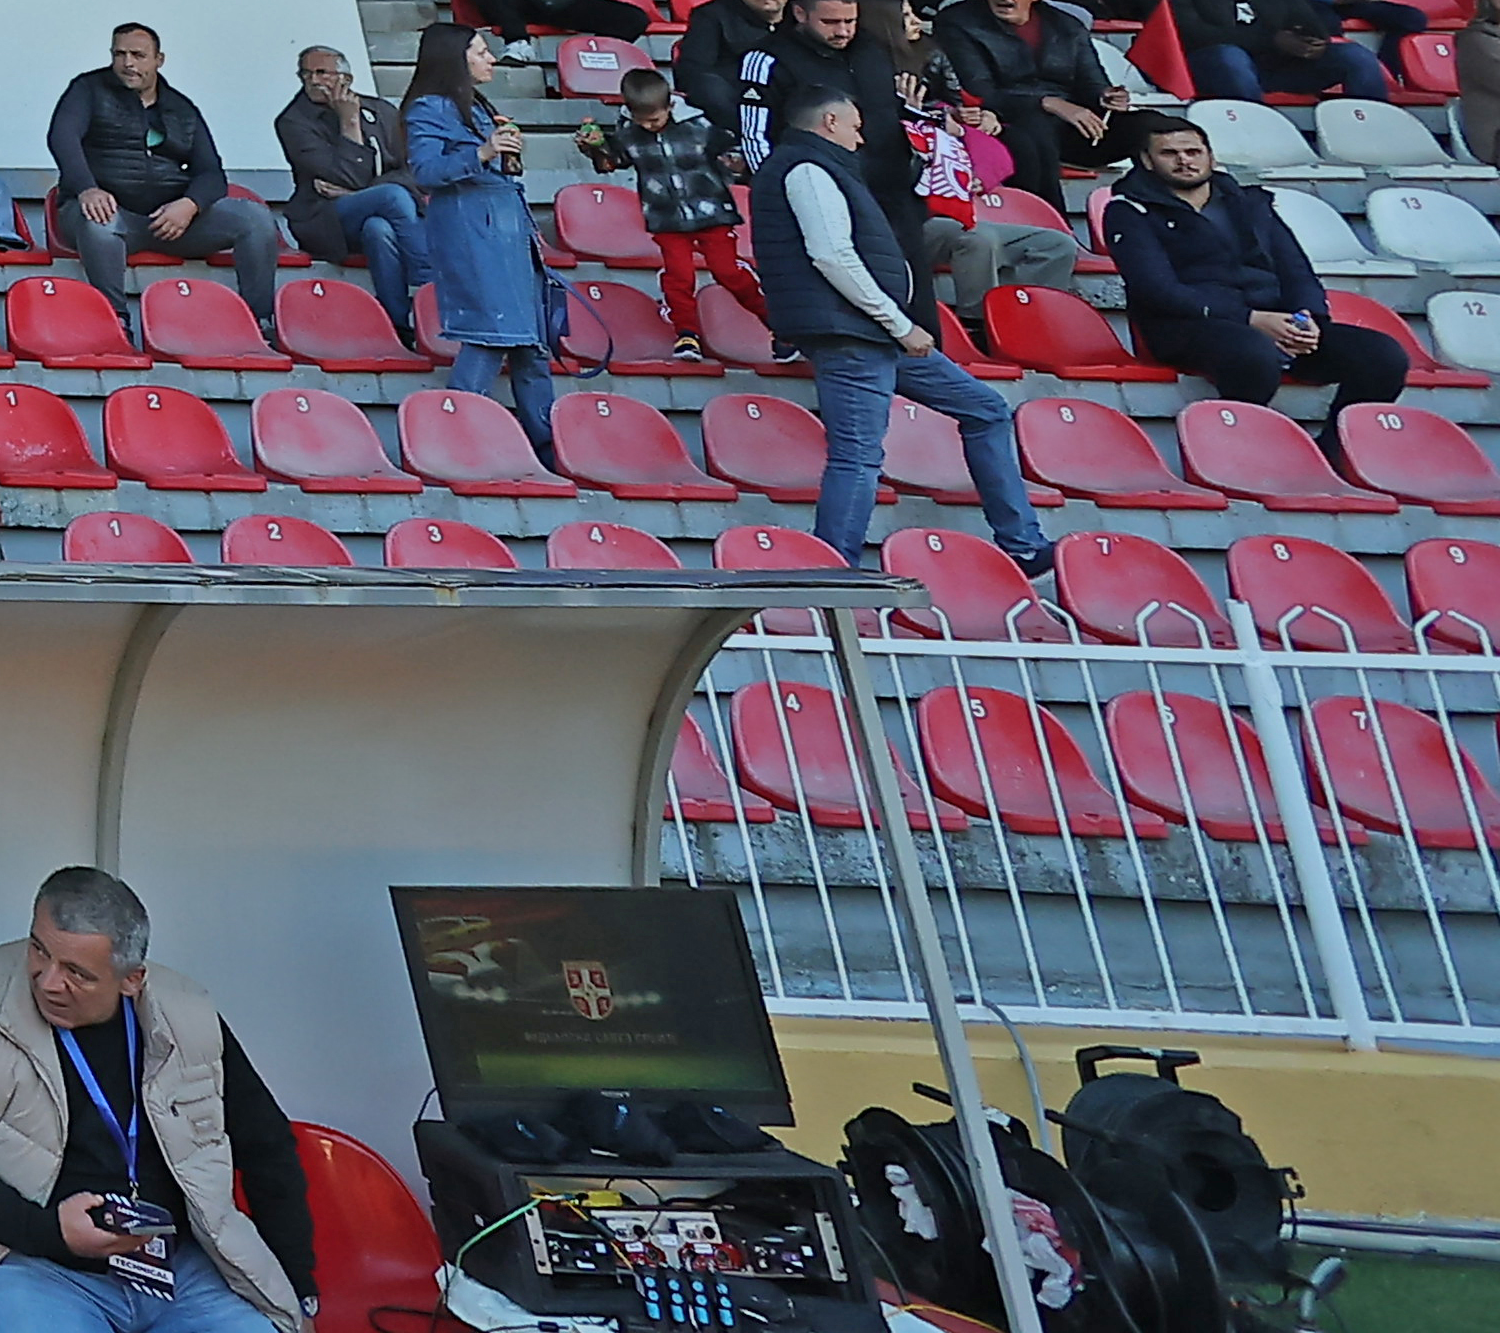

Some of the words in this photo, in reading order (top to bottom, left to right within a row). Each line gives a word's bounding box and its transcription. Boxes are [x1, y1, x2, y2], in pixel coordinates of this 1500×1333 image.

[588, 39, 598, 52] 1
[1226, 109, 1237, 122] 5
[1353, 109, 1366, 121] 6
[593, 190, 603, 203] 7
[981, 194, 1002, 207] 10
[1400, 197, 1422, 210] 13
[42, 280, 55, 294] 2
[178, 282, 190, 296] 3
[313, 283, 324, 296] 4
[589, 286, 601, 300] 6
[1016, 289, 1029, 304] 9
[1463, 301, 1487, 316] 12
[6, 391, 16, 406] 1
[147, 393, 160, 409] 2
[296, 397, 309, 412] 3
[442, 398, 455, 413] 4
[597, 401, 609, 416] 5
[747, 403, 760, 419] 6
[903, 405, 917, 420] 7
[1060, 407, 1074, 422] 8
[1221, 410, 1235, 426] 9
[1377, 413, 1402, 429] 10
[110, 520, 120, 536] 1
[267, 523, 282, 539] 2
[428, 526, 442, 542] 3
[590, 527, 603, 543] 4
[757, 532, 771, 549] 5
[928, 534, 942, 551] 6
[1096, 538, 1109, 554] 7
[1273, 543, 1289, 560] 8
[1449, 546, 1465, 563] 9
[786, 693, 800, 711] 4
[970, 698, 987, 718] 5
[1352, 711, 1367, 730] 7
[114, 1257, 169, 1281] TECHNICAL
